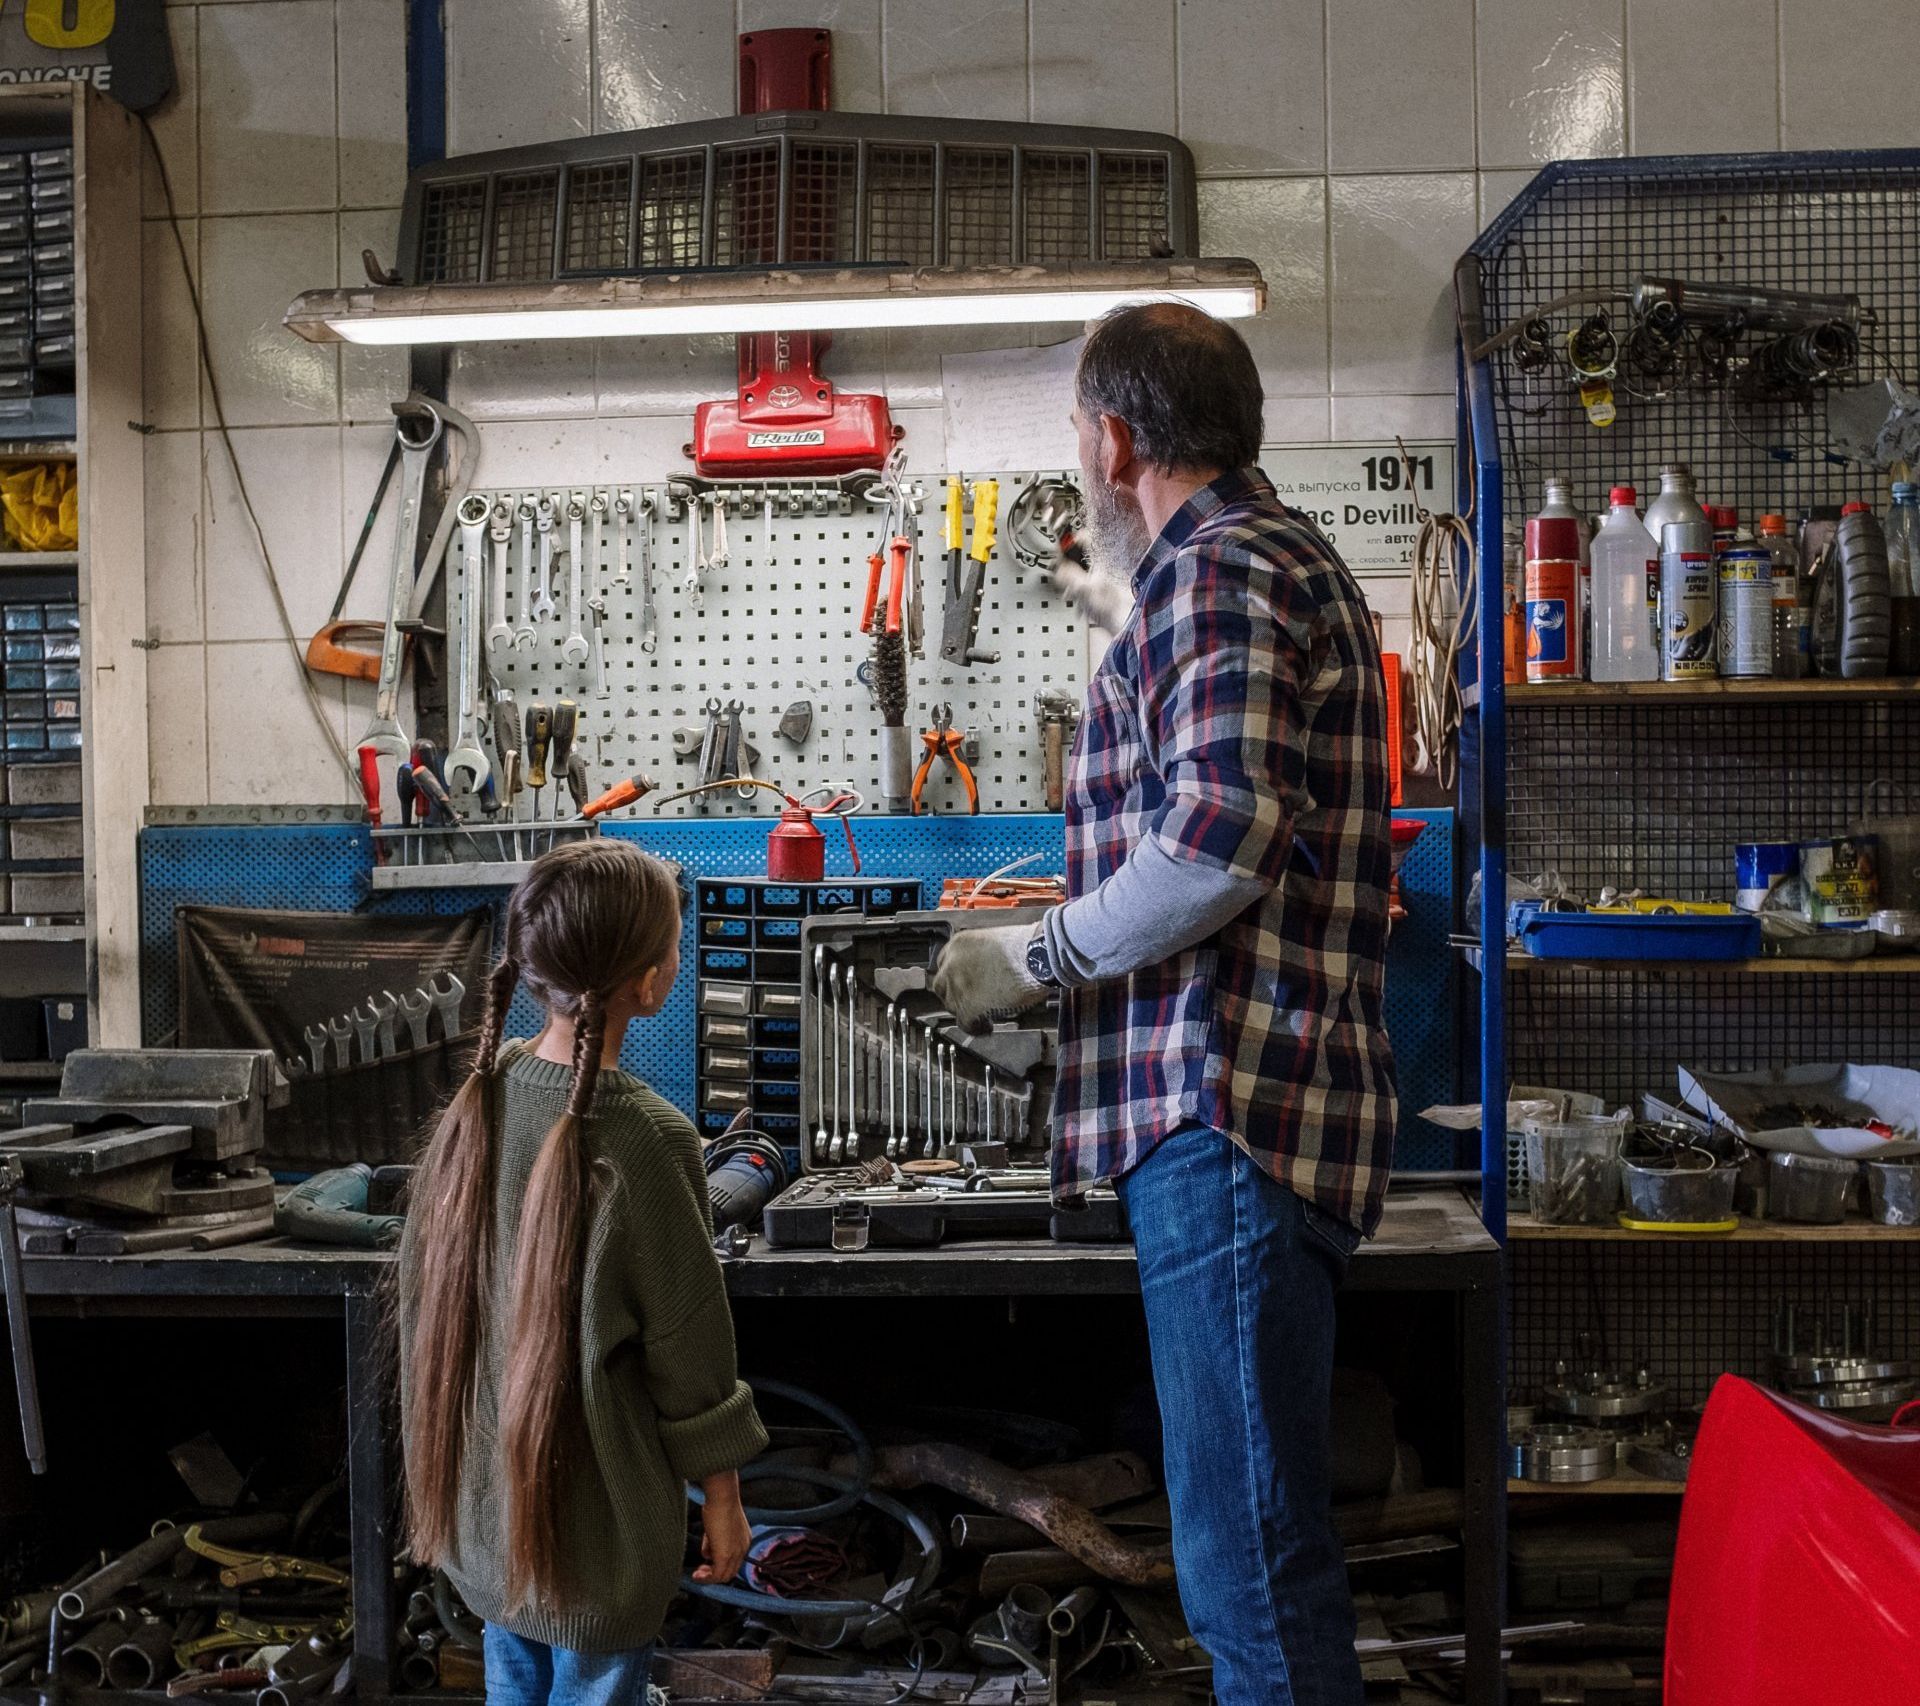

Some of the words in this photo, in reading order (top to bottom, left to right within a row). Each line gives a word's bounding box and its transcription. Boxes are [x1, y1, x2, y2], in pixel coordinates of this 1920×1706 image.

[1299, 481, 1361, 494] выпуска
[1361, 456, 1434, 491] 1971
[1344, 503, 1430, 526] Deville
[1359, 556, 1396, 565] скорость
[351, 961, 369, 970] SET
